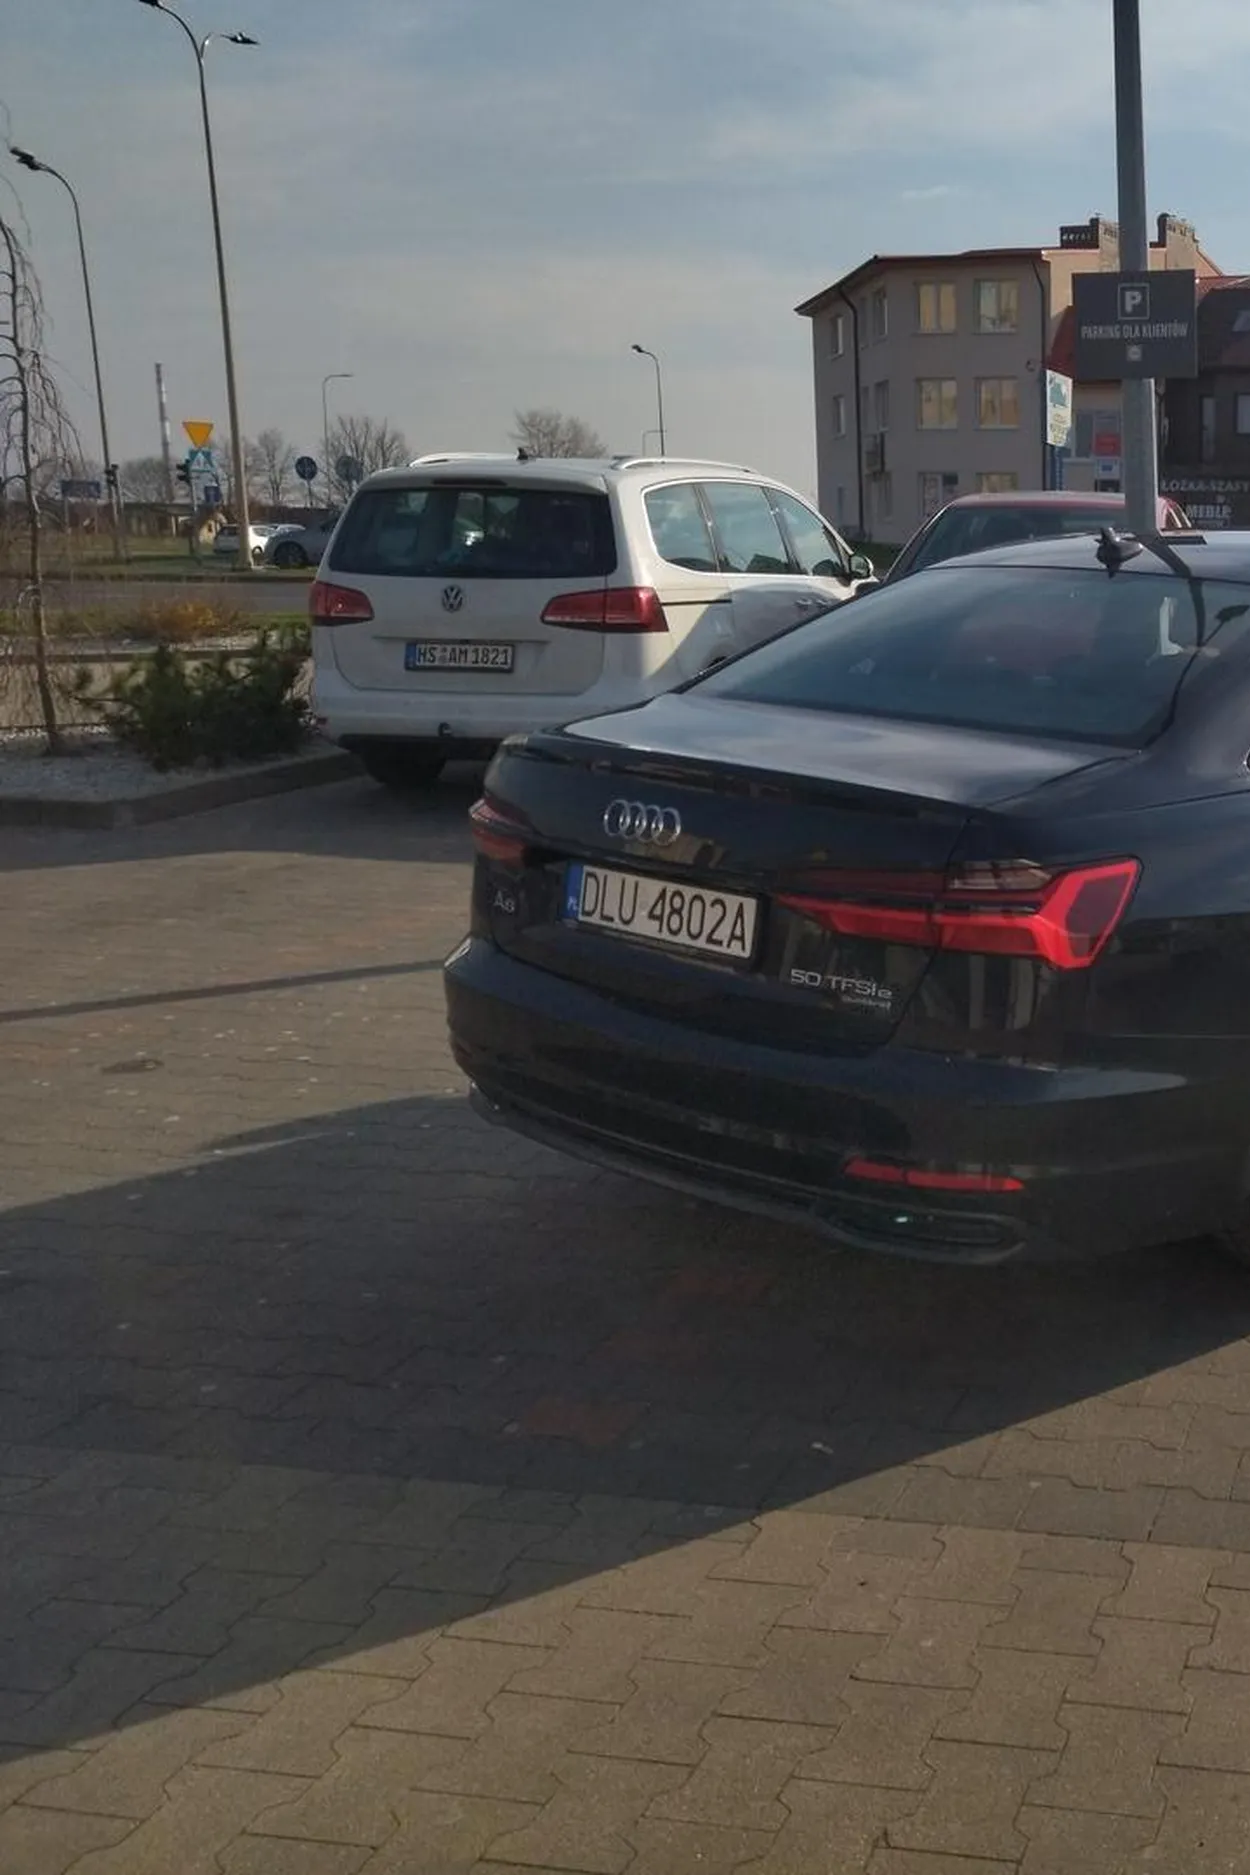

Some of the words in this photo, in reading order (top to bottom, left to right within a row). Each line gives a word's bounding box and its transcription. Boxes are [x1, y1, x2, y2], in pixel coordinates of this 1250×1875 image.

[1124, 290, 1141, 313] P
[1081, 324, 1121, 339] PARKING
[1122, 323, 1140, 338] DLA
[417, 646, 437, 664] HS
[448, 647, 468, 665] AM
[471, 647, 509, 666] 1821
[580, 871, 640, 926] DLU
[648, 886, 747, 952] 4802A
[790, 968, 821, 987] 50
